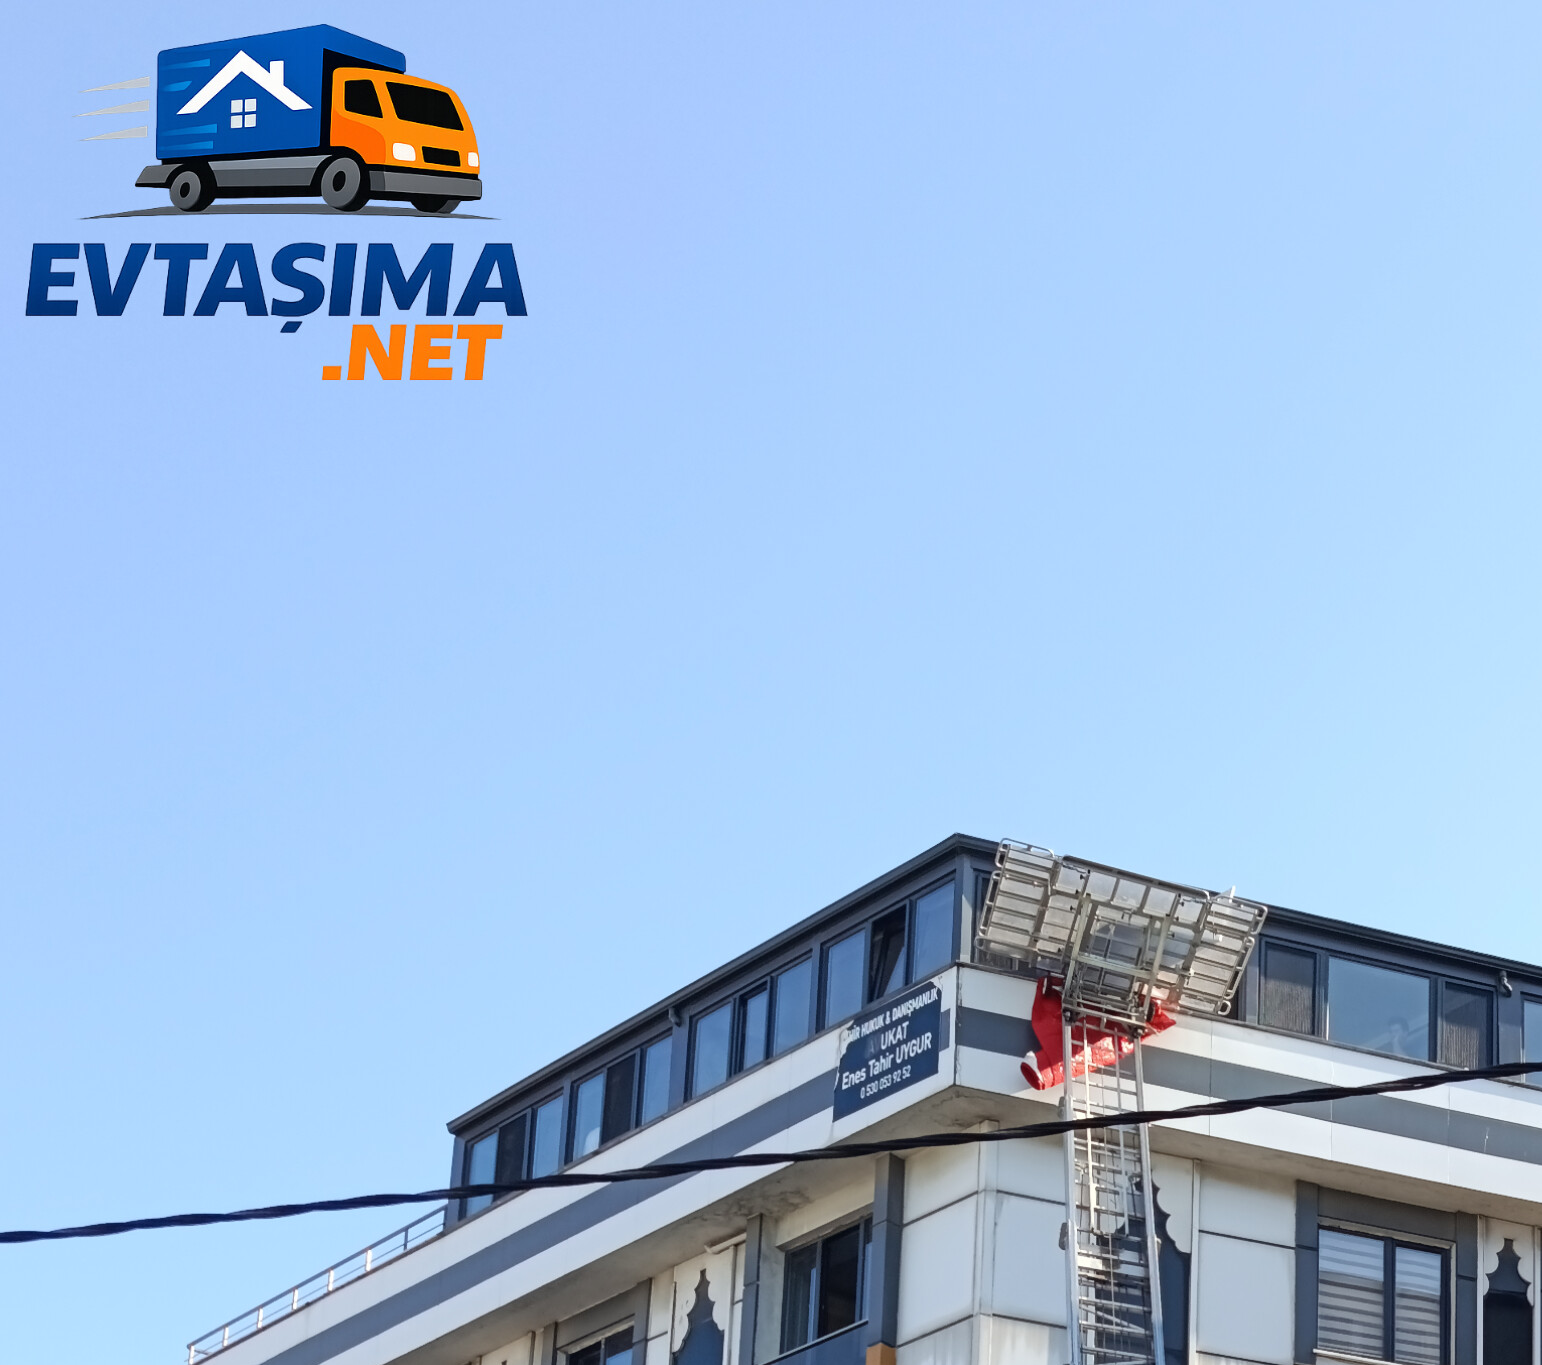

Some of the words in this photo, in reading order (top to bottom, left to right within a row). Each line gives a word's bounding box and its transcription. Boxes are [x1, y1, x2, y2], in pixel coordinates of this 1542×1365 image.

[875, 1021, 909, 1053] UKAT
[842, 1068, 866, 1090] Enes
[868, 1052, 893, 1077] Tahir
[896, 1032, 932, 1064] UYGUR
